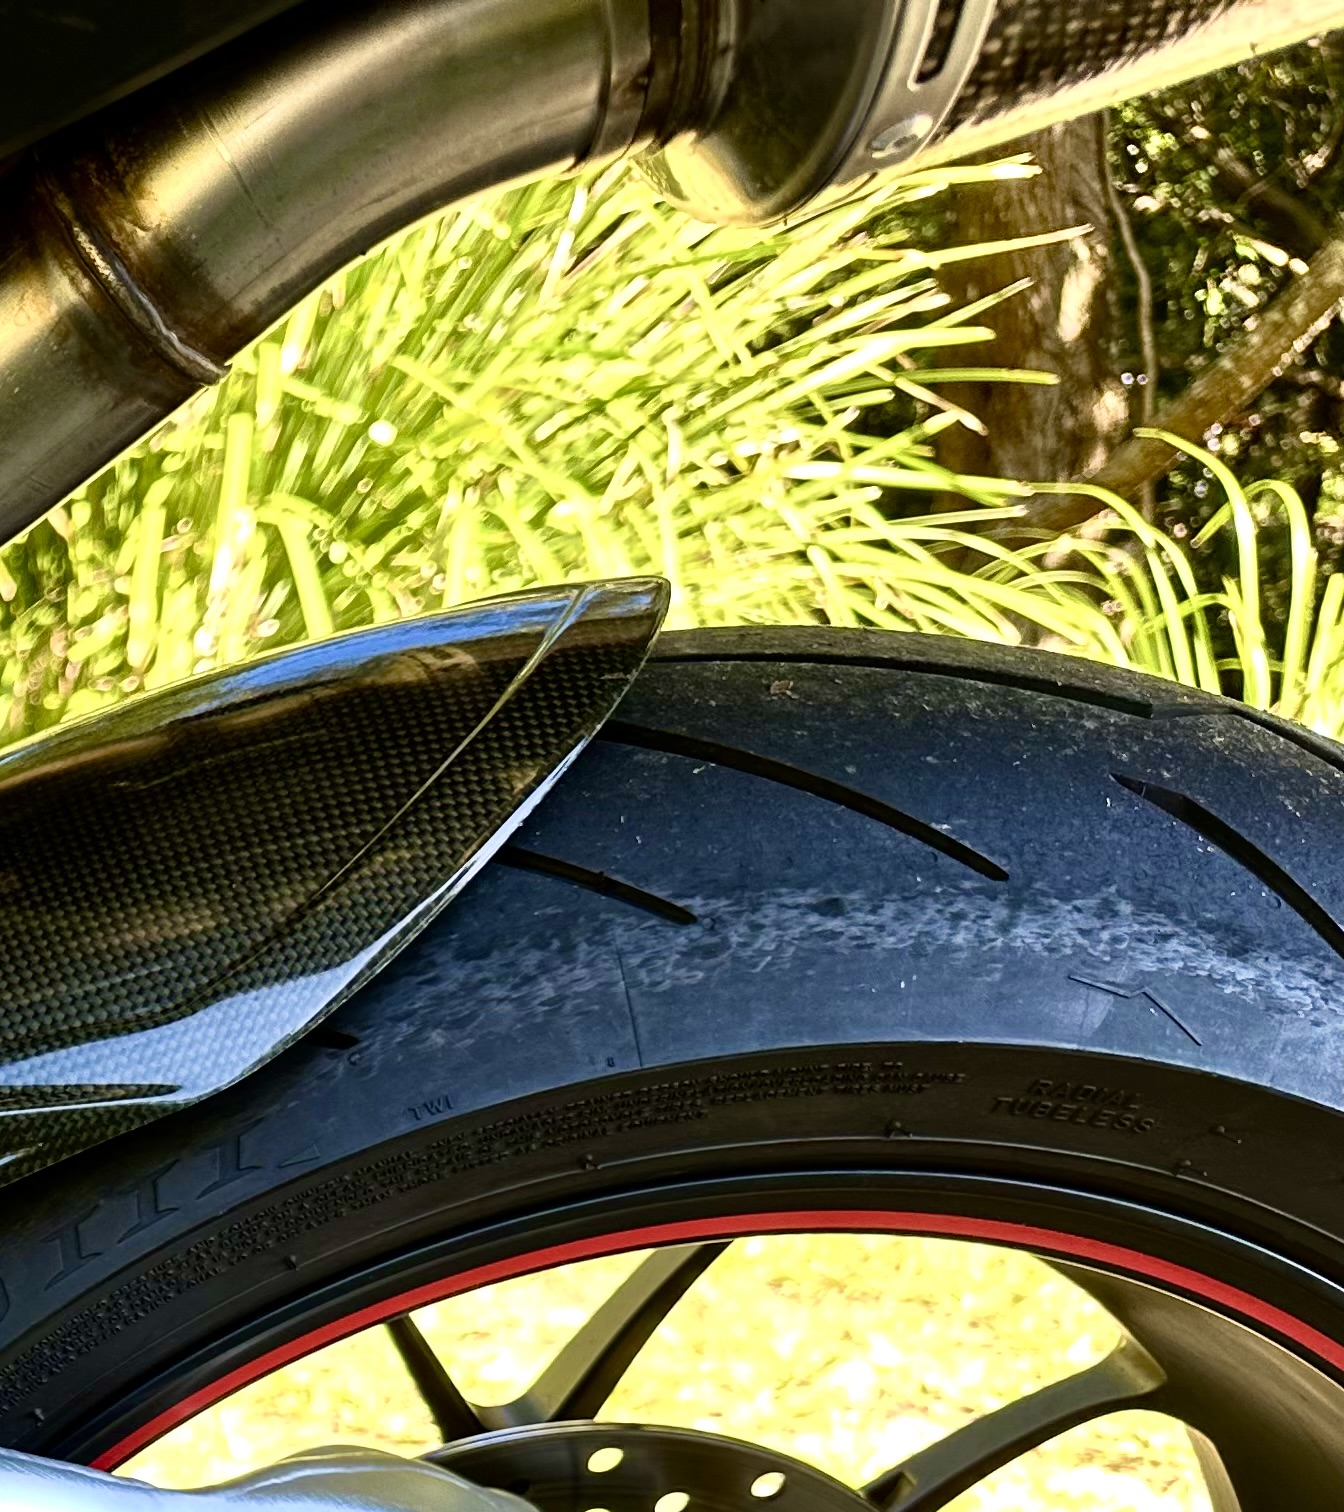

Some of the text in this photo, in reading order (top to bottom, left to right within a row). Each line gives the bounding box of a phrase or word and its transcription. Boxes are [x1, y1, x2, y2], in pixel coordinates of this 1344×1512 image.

[407, 1095, 454, 1121] TWI
[1026, 1077, 1143, 1111] RADIAL
[989, 1094, 1156, 1136] TUBELESS
